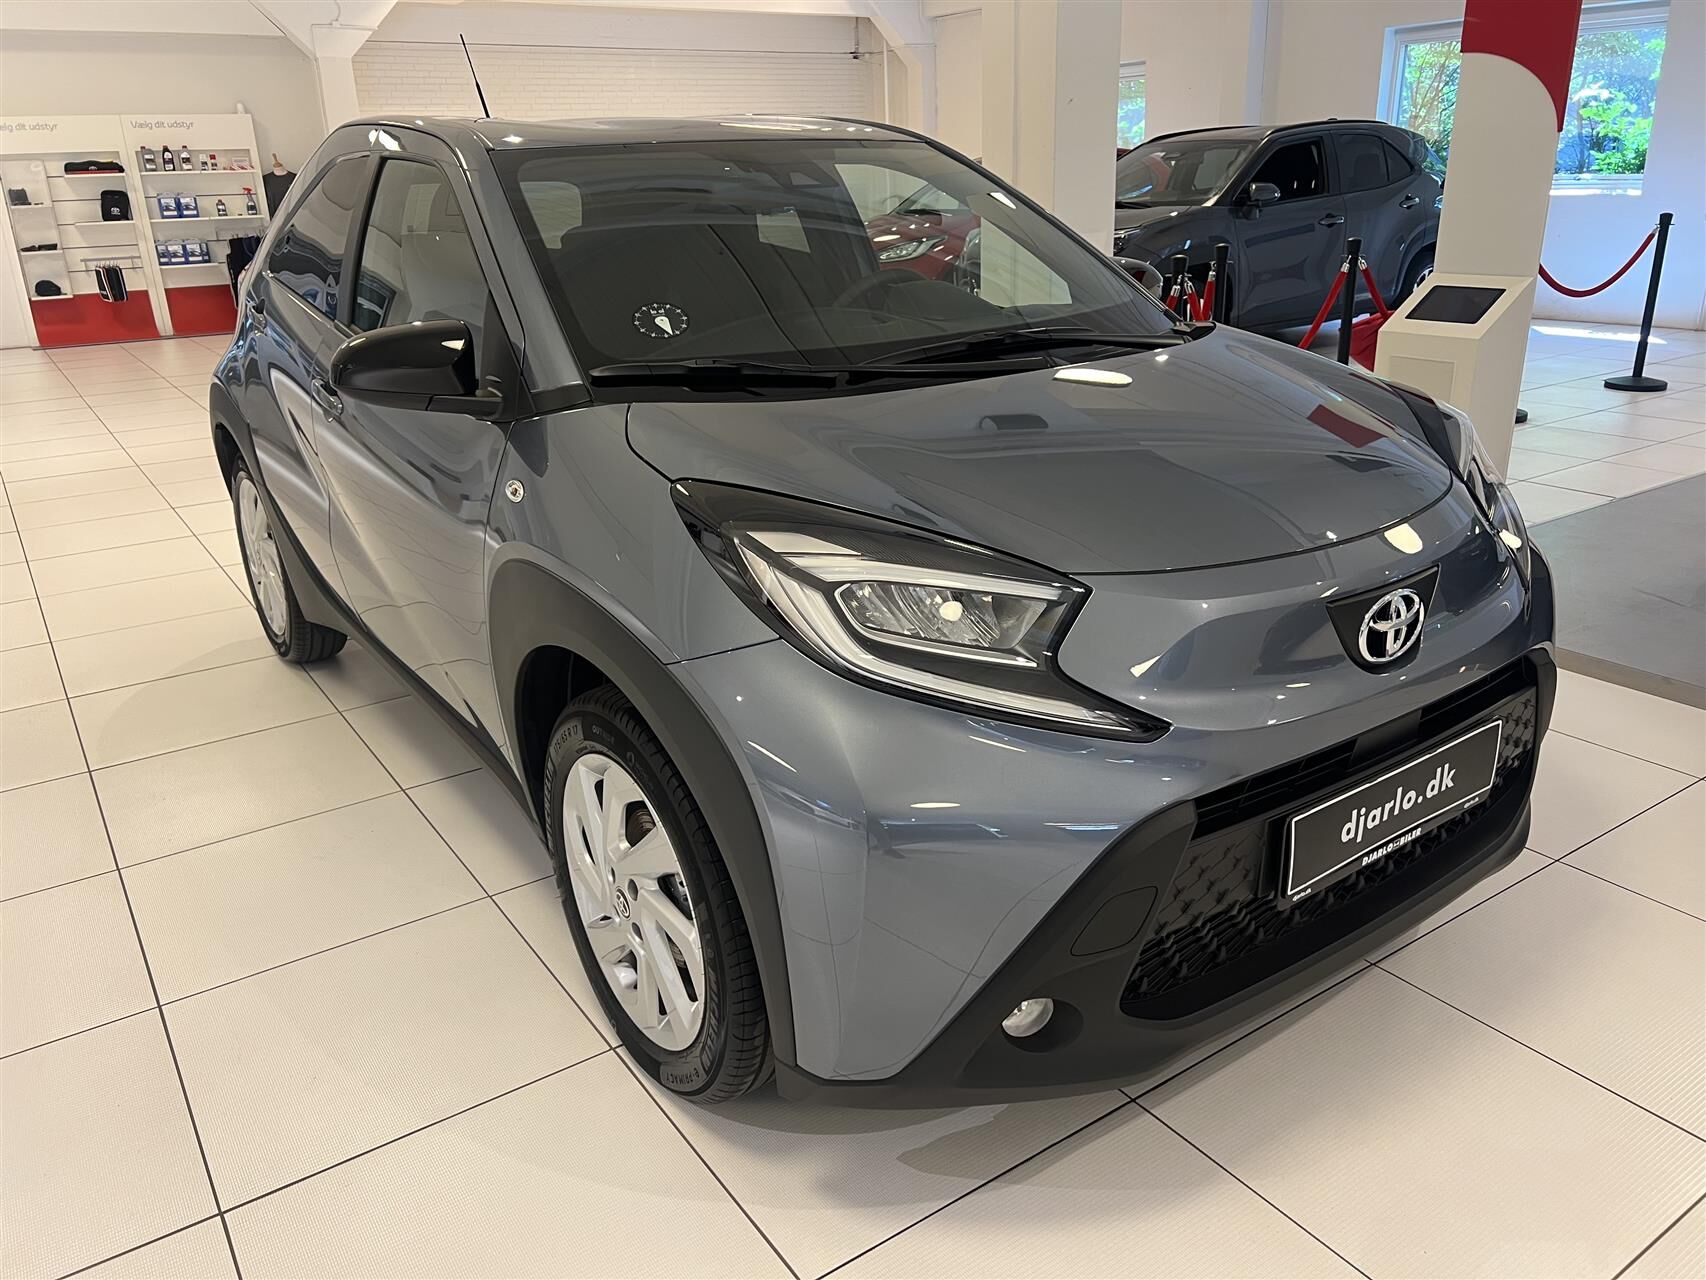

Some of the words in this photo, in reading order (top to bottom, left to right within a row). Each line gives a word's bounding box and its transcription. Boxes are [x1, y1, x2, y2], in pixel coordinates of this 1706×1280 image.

[29, 122, 58, 132] udstyr
[130, 120, 153, 130] Vælg
[167, 120, 193, 130] udstyr
[1341, 763, 1455, 843] djarlo.dk
[1362, 843, 1394, 867] DJARLO
[1399, 828, 1422, 846] BILER
